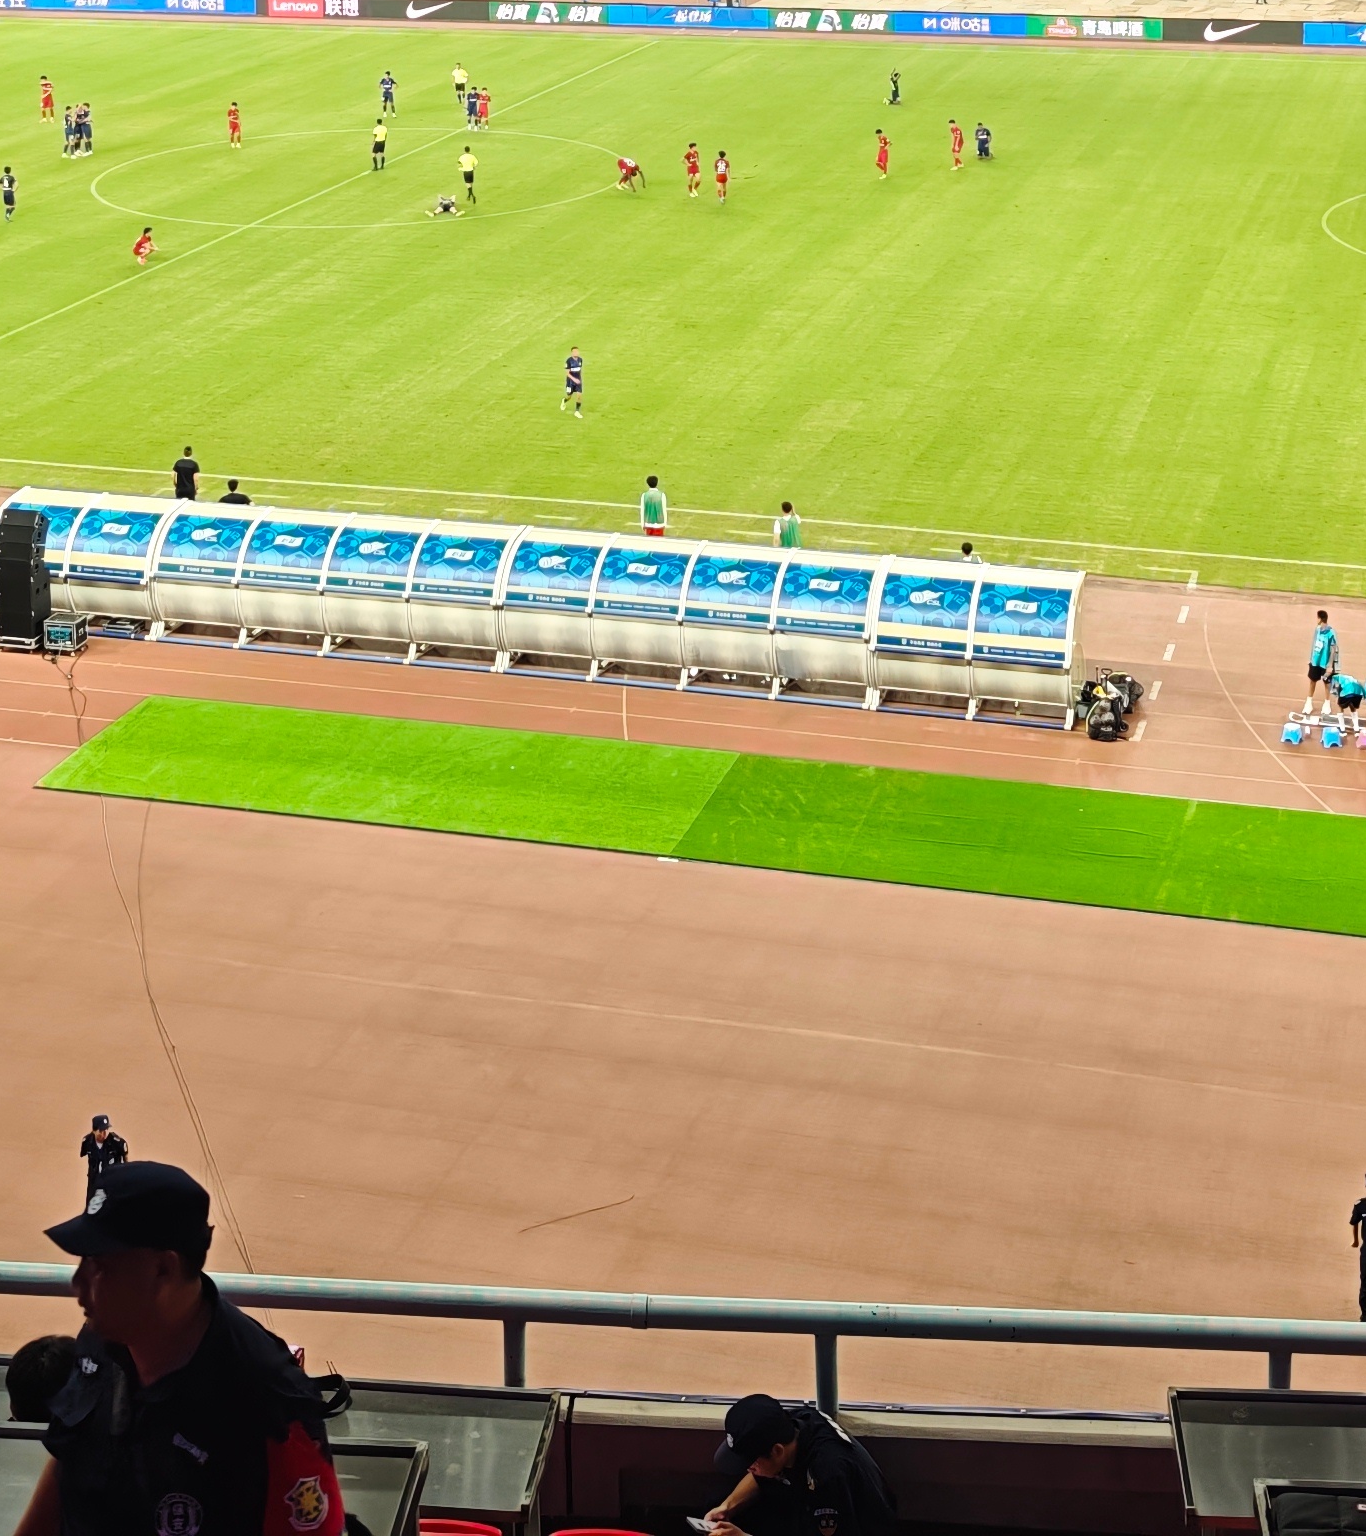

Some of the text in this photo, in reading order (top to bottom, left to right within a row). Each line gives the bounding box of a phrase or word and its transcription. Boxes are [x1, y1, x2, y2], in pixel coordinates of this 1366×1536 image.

[272, 0, 319, 13] Lenovo
[1081, 19, 1144, 38] 青岛啤酒
